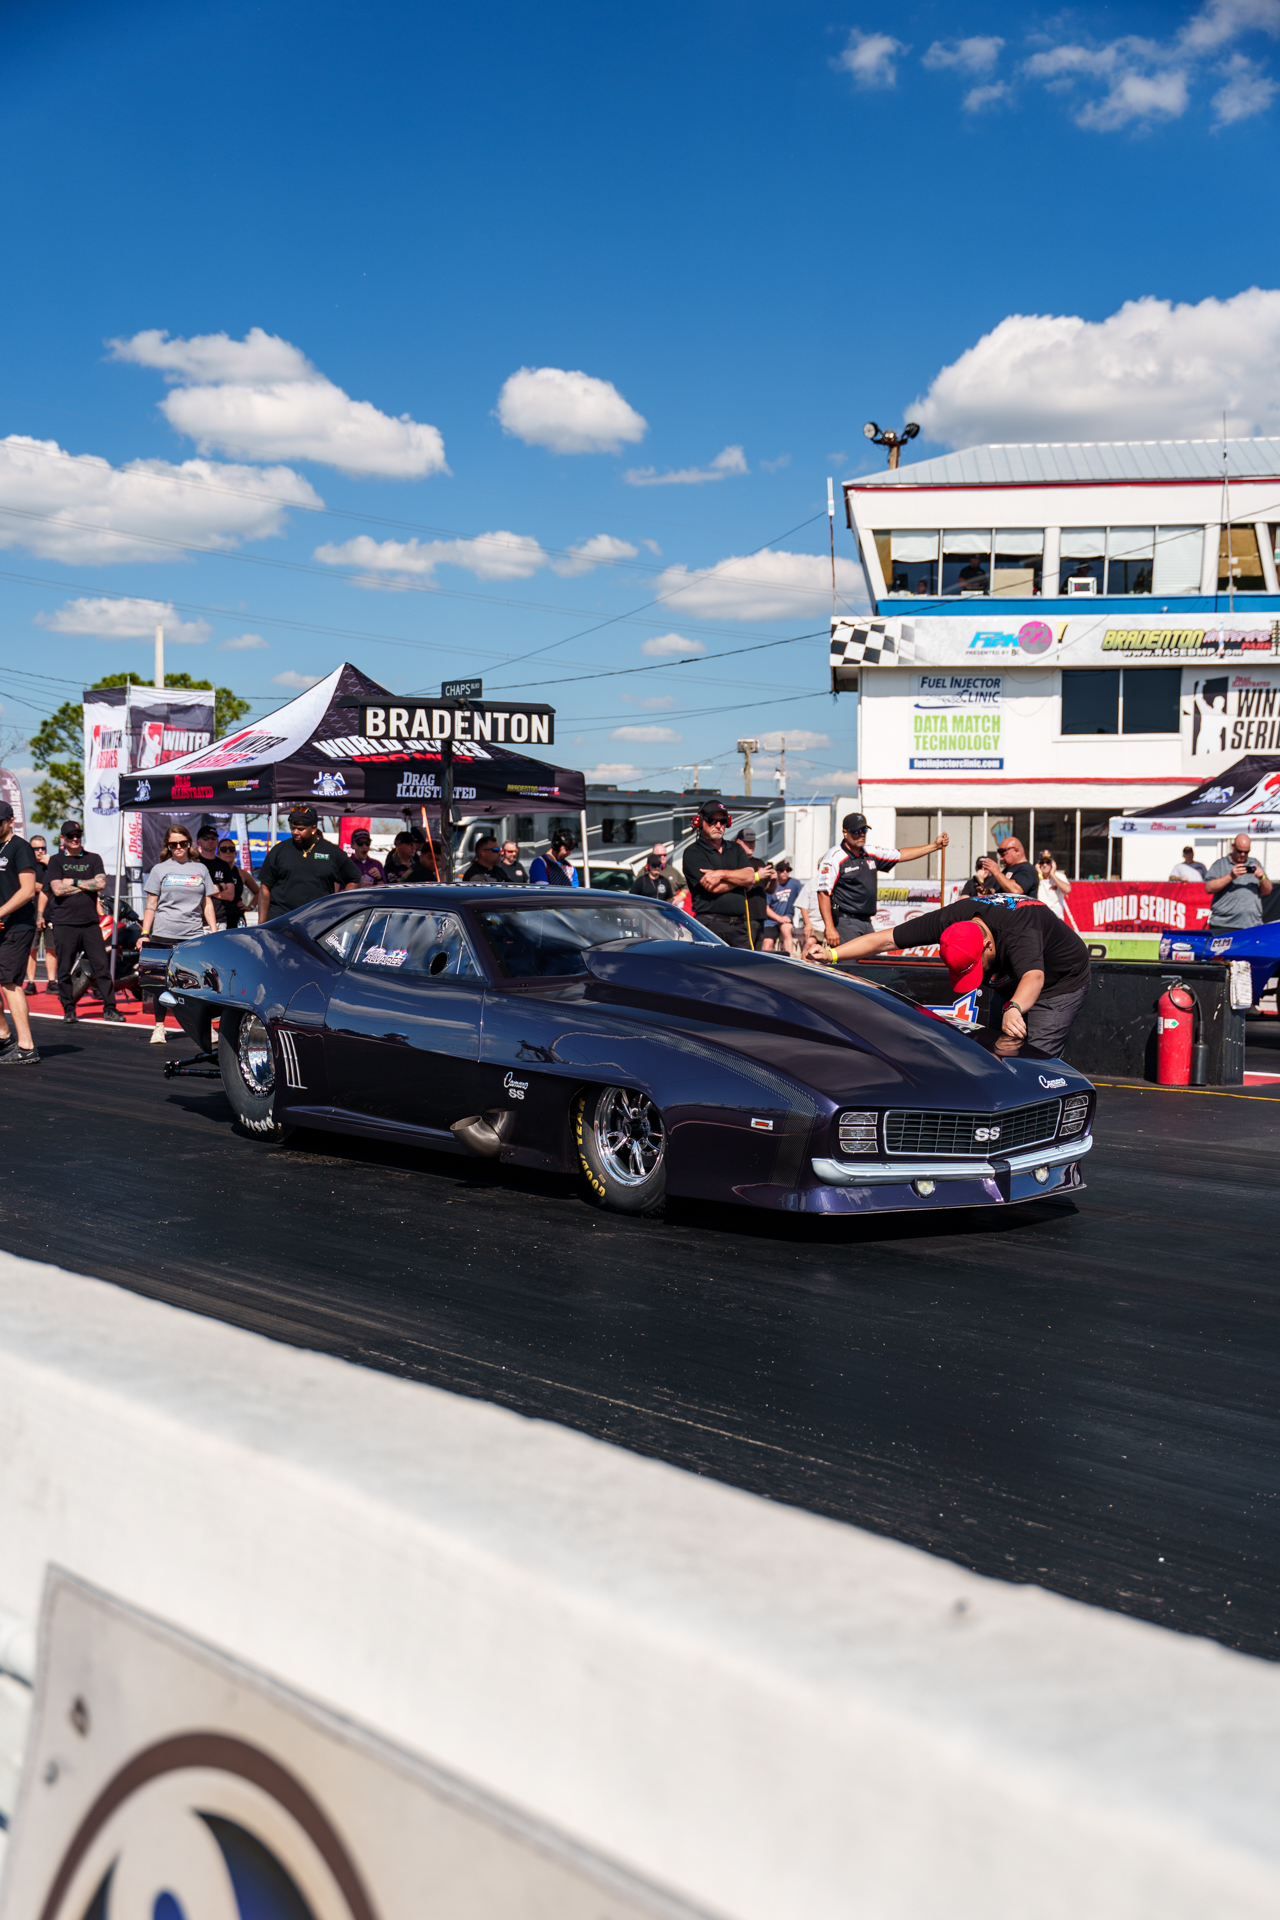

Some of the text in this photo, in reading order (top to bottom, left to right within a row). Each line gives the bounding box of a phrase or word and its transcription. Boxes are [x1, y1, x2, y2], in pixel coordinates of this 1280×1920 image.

[1102, 629, 1204, 650] BRADENTON
[445, 683, 471, 696] CHAPS
[920, 676, 1002, 689] FUEL INJECTOR
[960, 689, 1001, 703] CLINIC
[1237, 688, 1280, 717] WIN
[366, 706, 549, 743] BRADENTON
[914, 715, 1001, 733] DATA MATCH
[163, 730, 211, 752] WINTER
[914, 734, 1001, 751] TECHNOLOGY
[411, 752, 476, 764] MD
[174, 774, 191, 787] DRAG
[313, 771, 346, 785] J&A
[403, 771, 436, 786] DRAG
[171, 786, 214, 800] ILLUSTRATED
[311, 789, 350, 797] SERVICE
[396, 783, 477, 799] ILLUSTTED
[1093, 895, 1186, 929] WORLD SERIES
[503, 1071, 529, 1089] Camaro
[508, 1088, 525, 1100] SS
[974, 1126, 1001, 1141] SS
